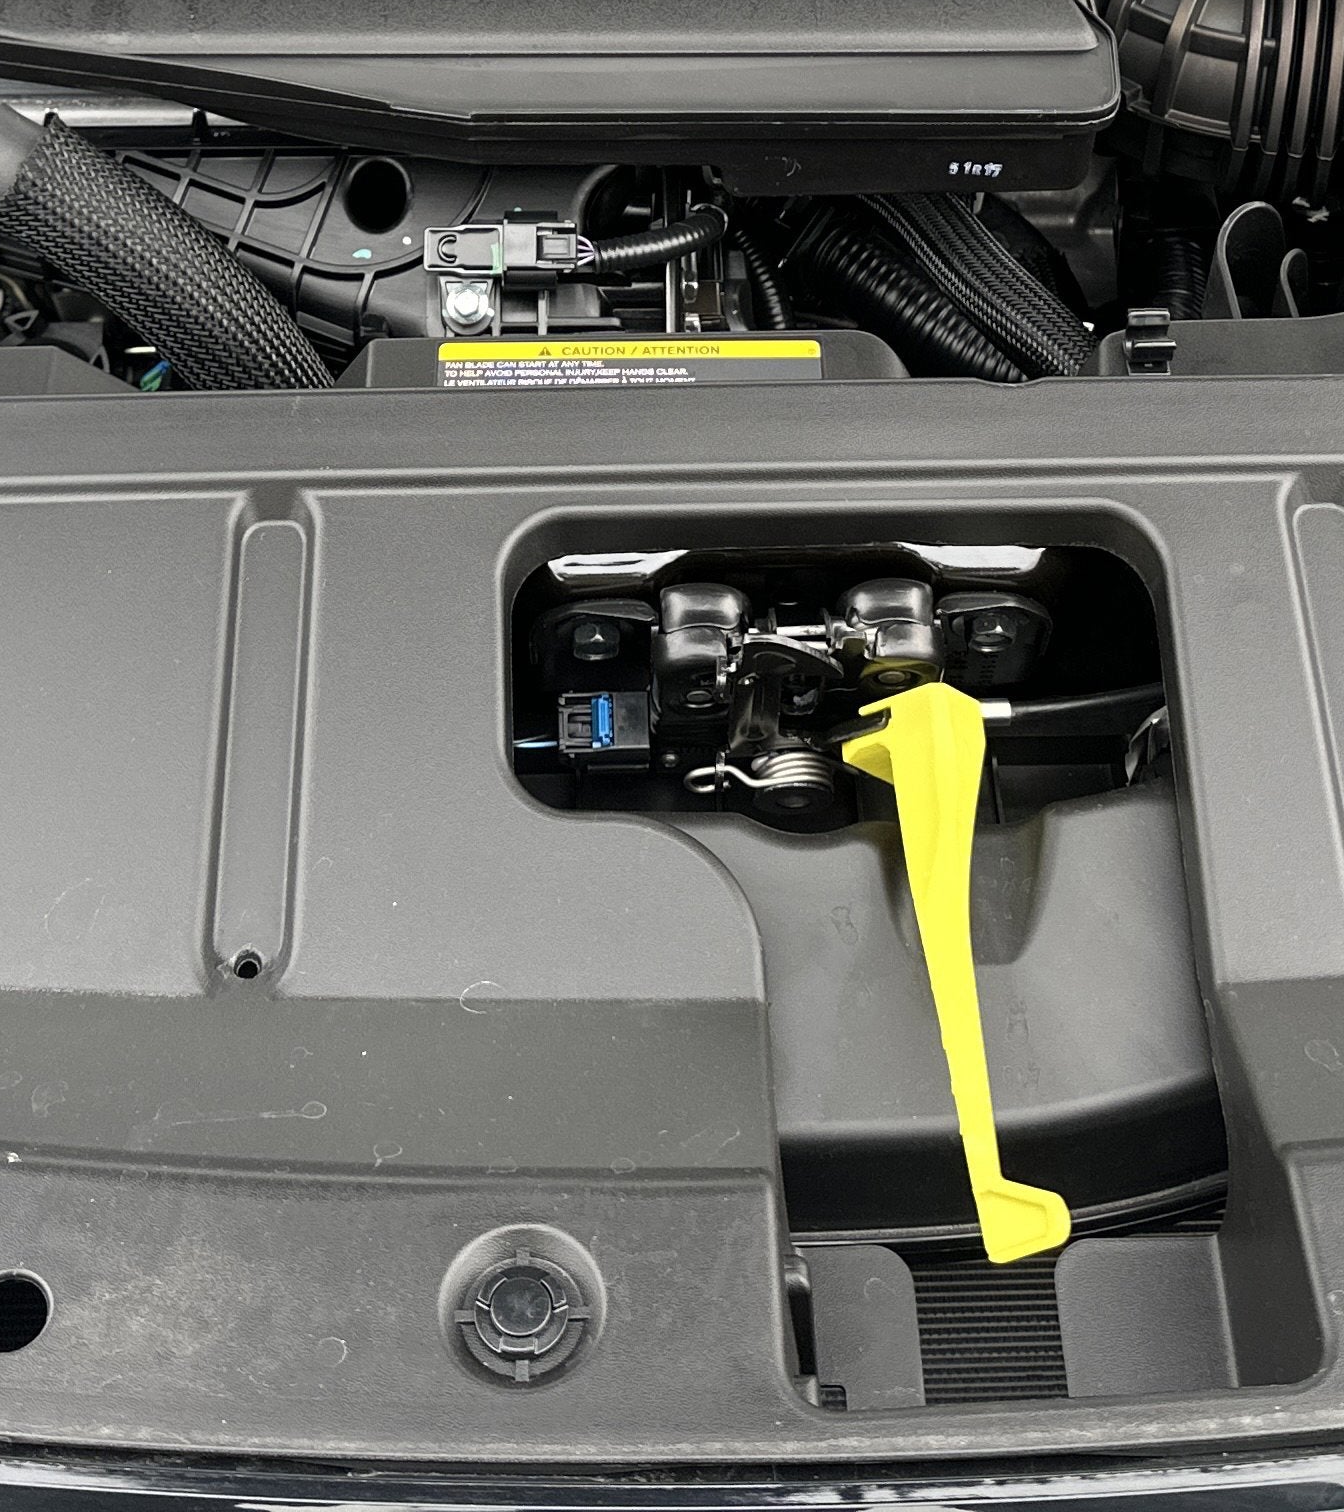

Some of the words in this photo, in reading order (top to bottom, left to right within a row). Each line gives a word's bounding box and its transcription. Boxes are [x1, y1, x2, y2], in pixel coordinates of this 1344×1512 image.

[561, 346, 626, 356] CAUTION
[642, 345, 720, 355] ATTENTION
[445, 361, 464, 370] FAN
[464, 361, 494, 369] BLADE
[496, 361, 517, 369] CAN
[548, 360, 560, 368] AT
[560, 360, 580, 368] ANY
[444, 369, 457, 377] TO
[459, 369, 483, 377] HELP
[484, 369, 512, 377] AVOID
[514, 369, 563, 377] PERSONAL
[621, 368, 655, 376] HANDS
